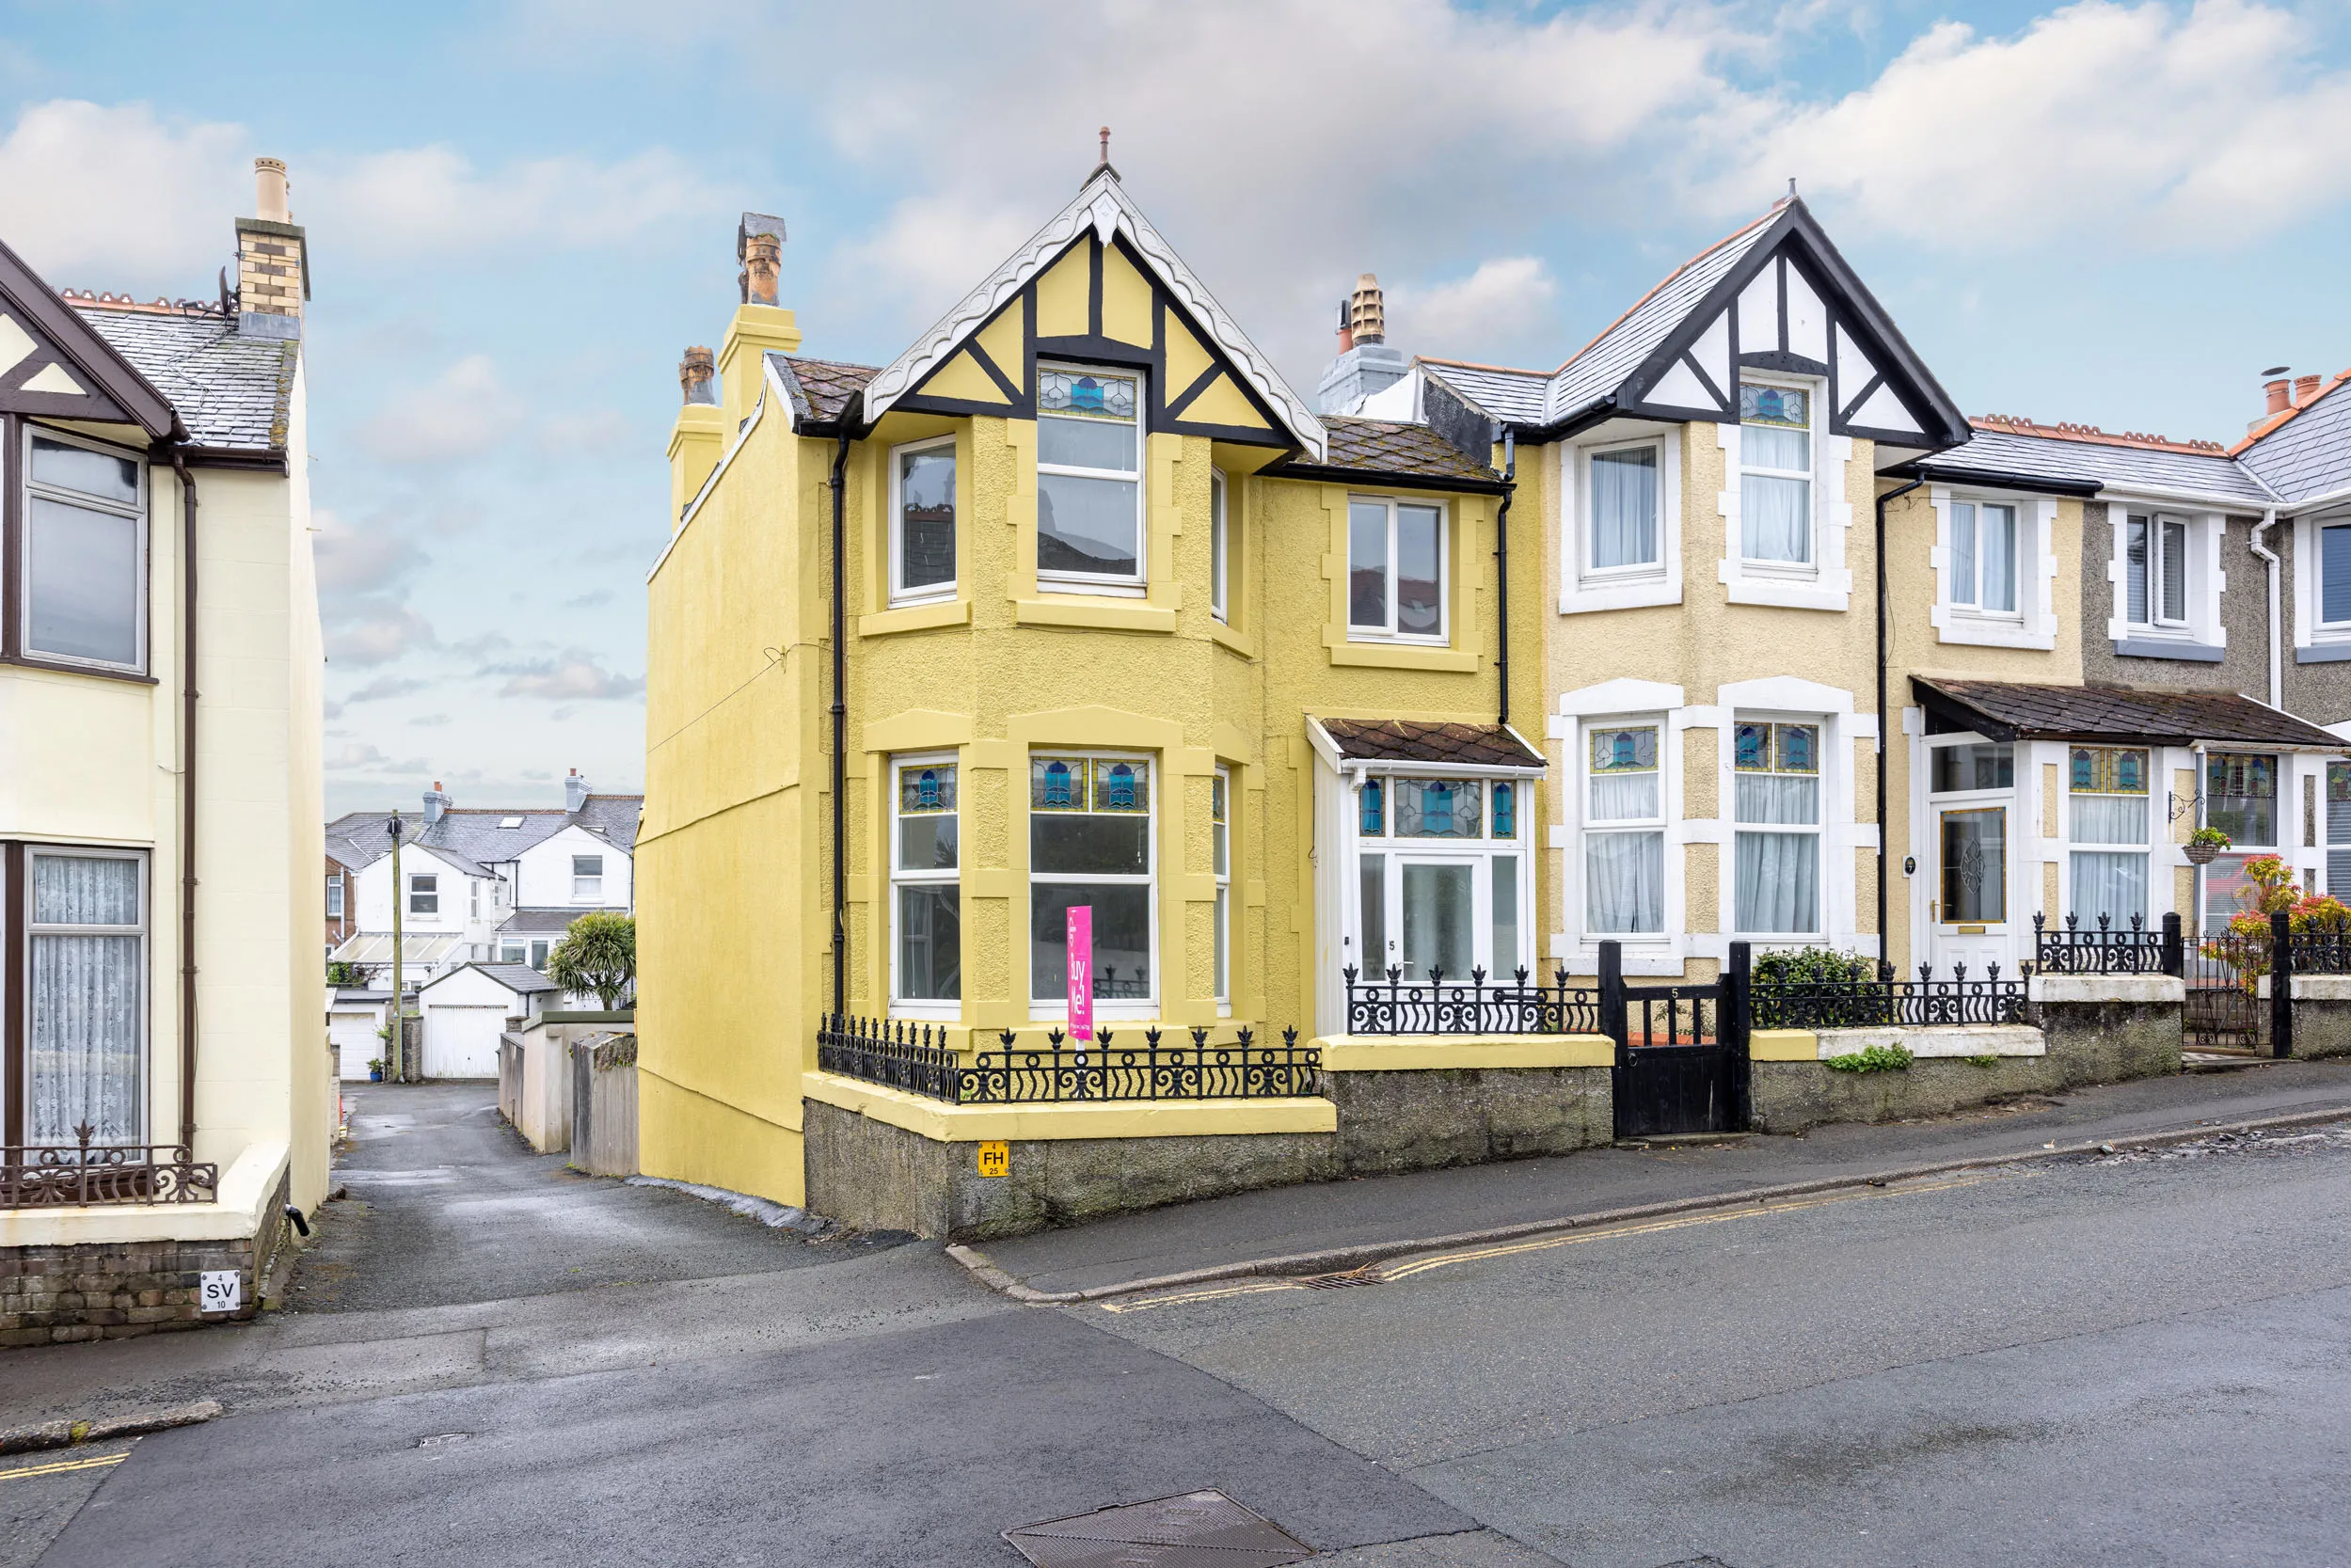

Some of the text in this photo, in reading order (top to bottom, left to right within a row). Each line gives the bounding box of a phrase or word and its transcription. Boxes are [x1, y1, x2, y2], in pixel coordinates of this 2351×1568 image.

[1389, 940, 1395, 951] 5
[1672, 988, 1678, 999] 5
[983, 1151, 1004, 1164] FH
[217, 1274, 223, 1282] 4
[206, 1283, 234, 1299] SV
[216, 1300, 226, 1308] 10
